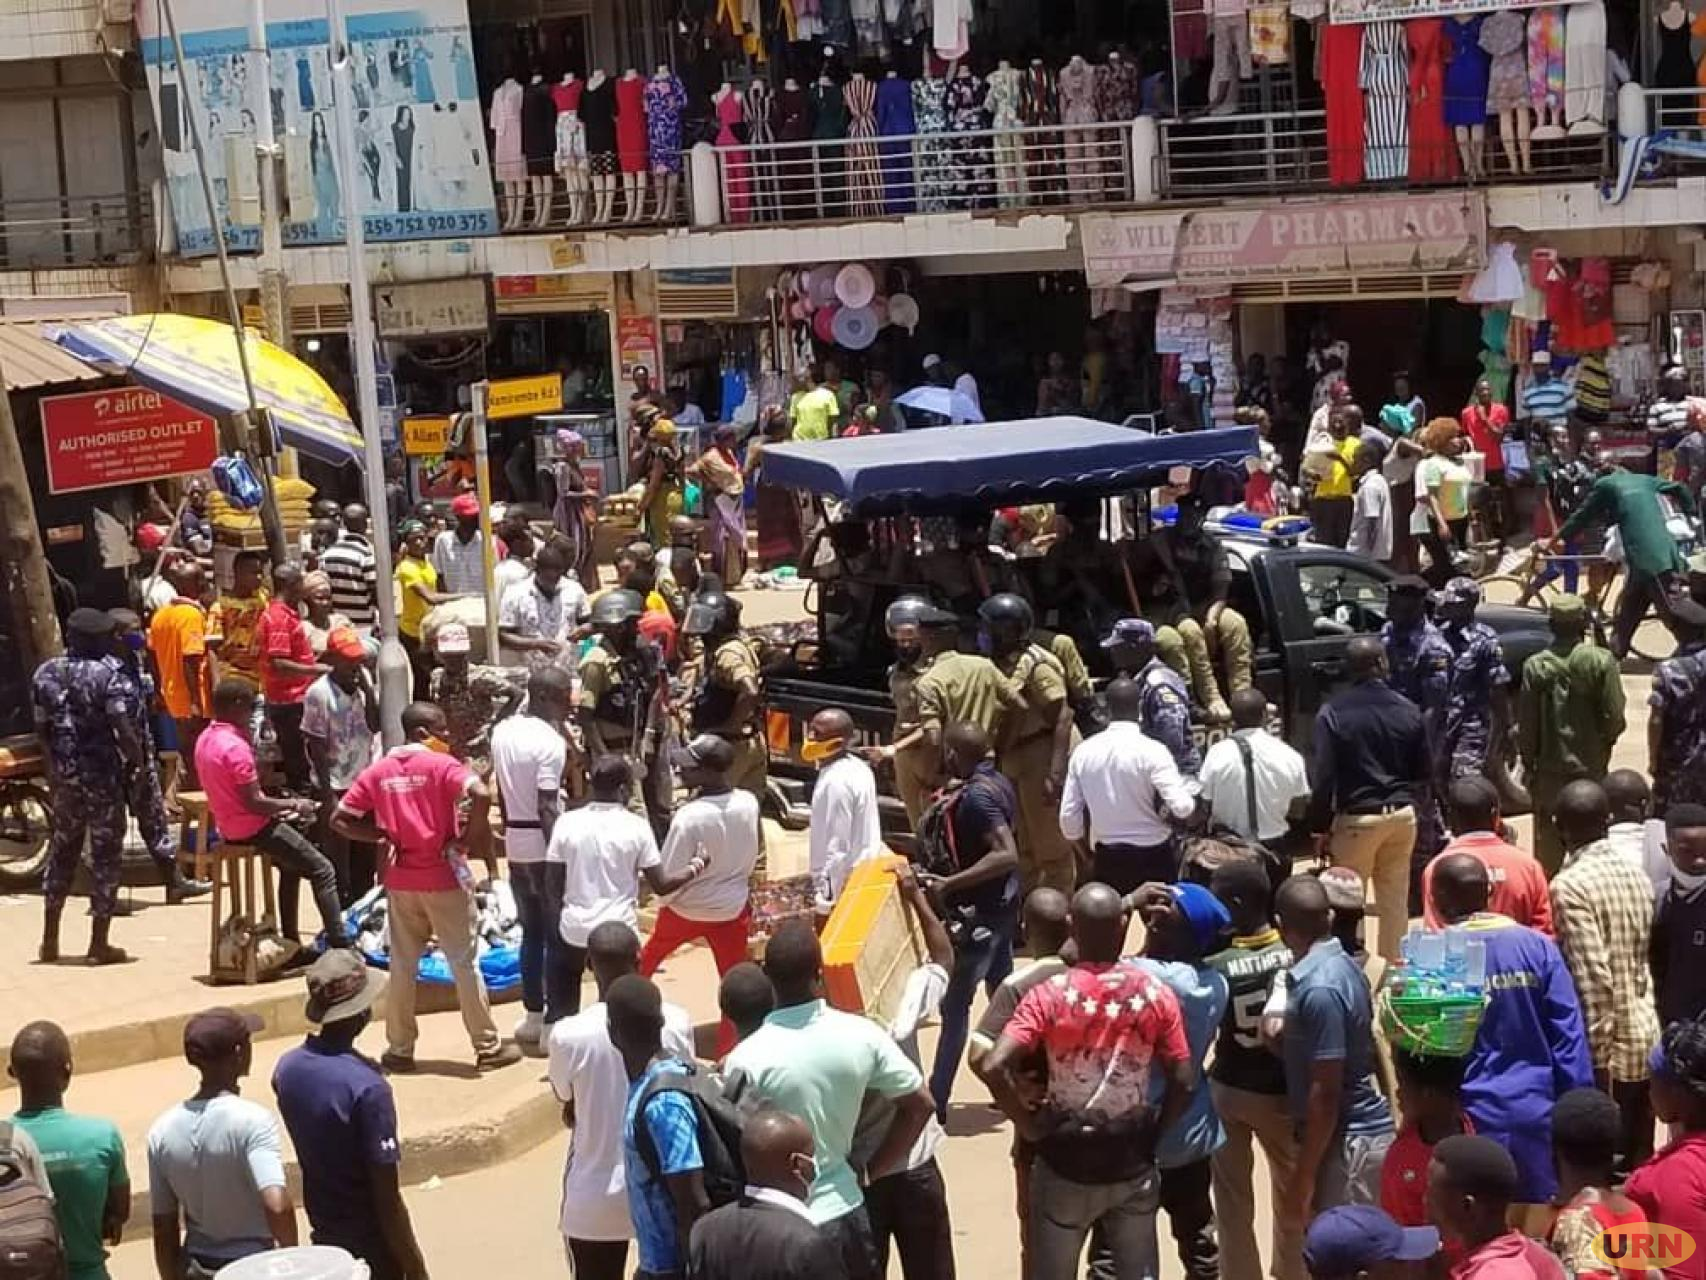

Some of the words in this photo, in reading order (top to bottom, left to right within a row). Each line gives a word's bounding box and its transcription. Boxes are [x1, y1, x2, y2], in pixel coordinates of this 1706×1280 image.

[1126, 221, 1241, 249] WILERT
[1269, 202, 1466, 247] PHARMACY
[114, 391, 163, 414] airtel
[59, 429, 147, 451] AUTHORISED
[150, 420, 204, 438] OUTLET
